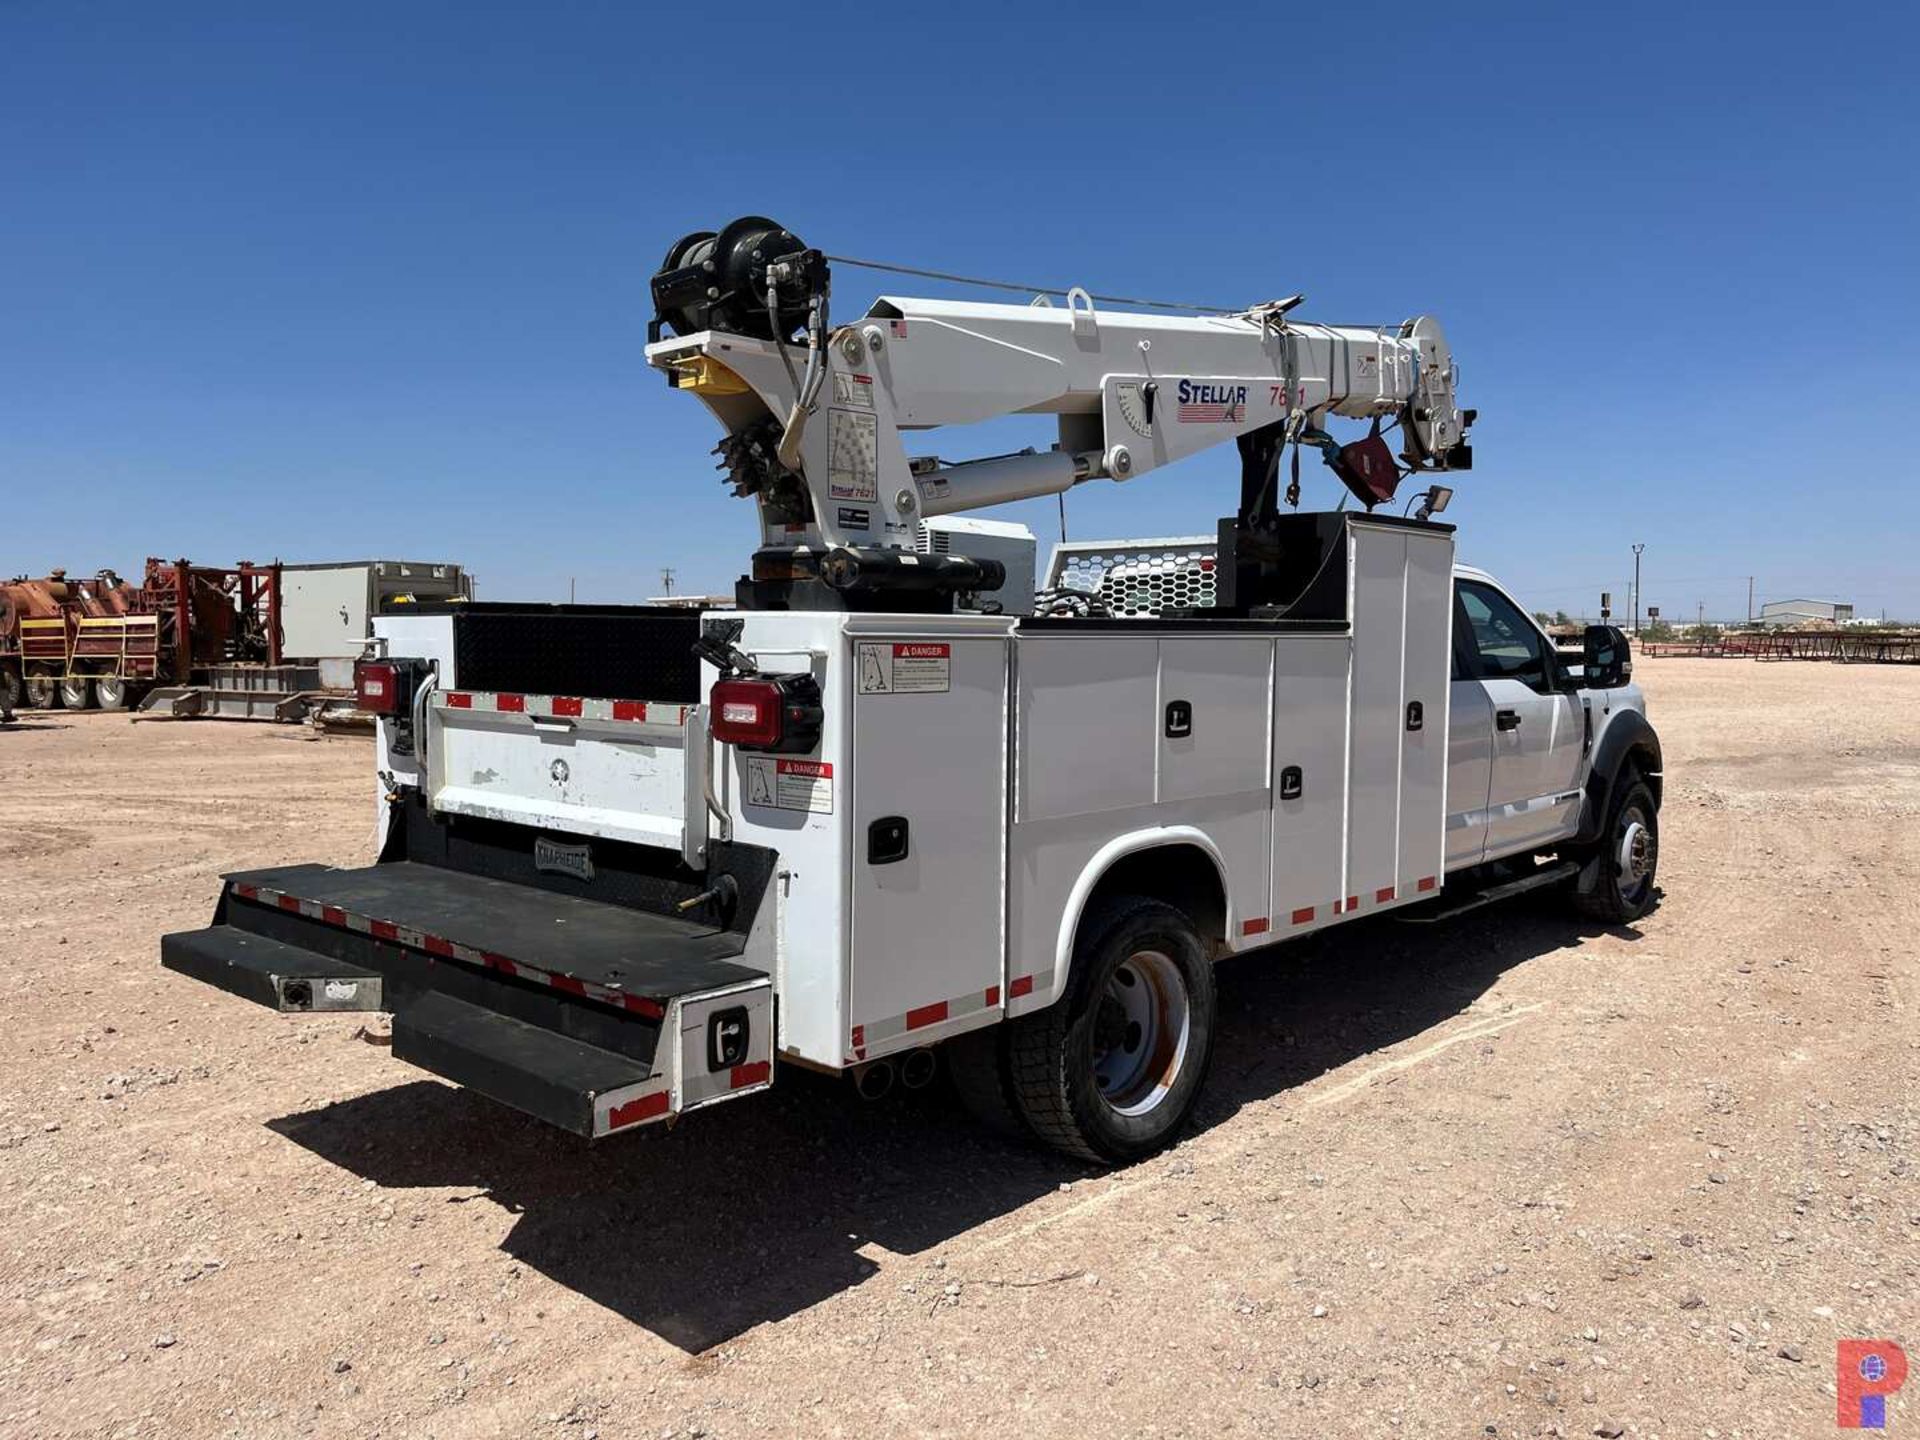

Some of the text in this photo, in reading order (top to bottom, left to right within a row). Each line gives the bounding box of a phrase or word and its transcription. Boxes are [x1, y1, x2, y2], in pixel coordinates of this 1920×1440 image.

[1178, 379, 1246, 404] STELLAR
[1270, 386, 1305, 405] 761
[855, 488, 874, 498] 7621
[911, 647, 942, 657] DANGER
[793, 765, 825, 775] DANGER
[536, 843, 587, 874] KNAPHEIDE
